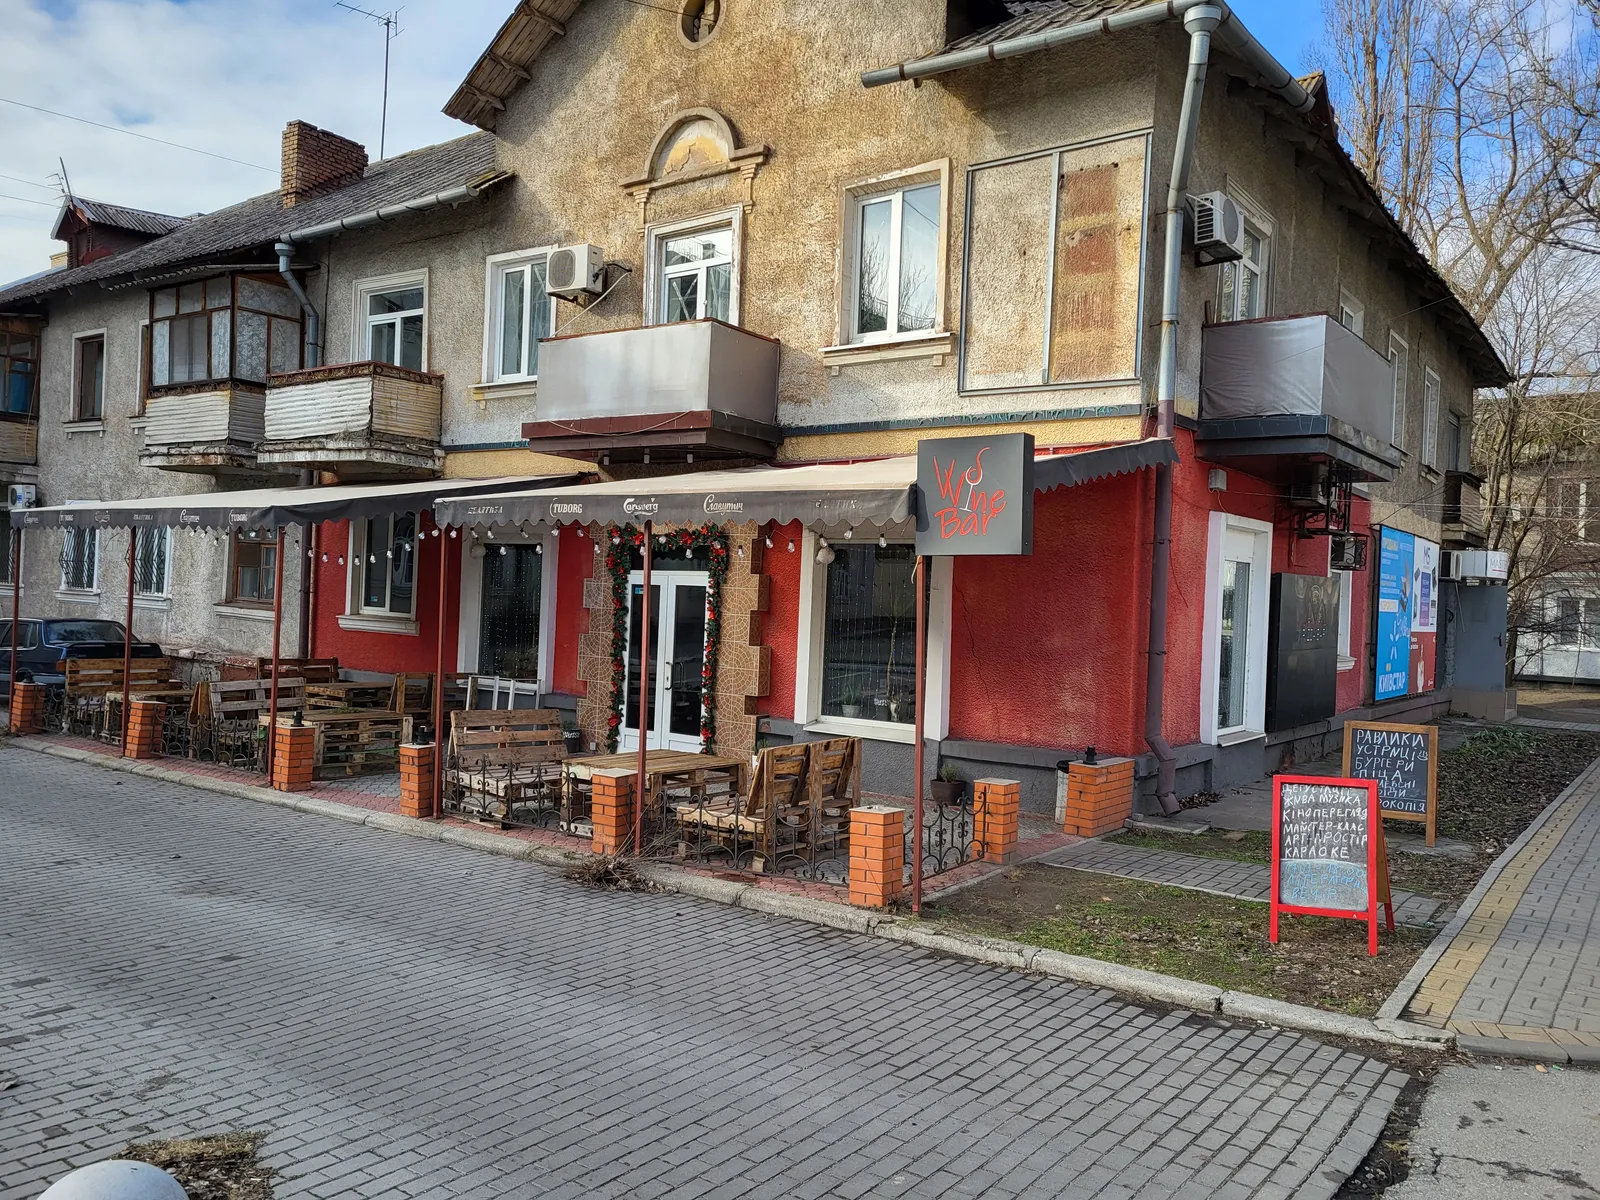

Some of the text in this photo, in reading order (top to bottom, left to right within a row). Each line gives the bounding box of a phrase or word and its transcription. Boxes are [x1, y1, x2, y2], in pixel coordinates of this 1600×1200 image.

[933, 446, 1007, 513] Wine
[552, 503, 583, 514] TUBORG
[703, 494, 743, 515] Славутич
[934, 507, 997, 539] Bar
[1356, 729, 1424, 747] РАВЛИКИ
[1355, 756, 1414, 772] БУРГЕРИ
[1283, 794, 1361, 806] ЖИВА МУЗИКА
[1283, 821, 1365, 835] МАЙСТЕР-КЛАС
[1284, 832, 1368, 846] АРТ-ПРОСТІР
[1285, 845, 1350, 859] КАРАОКЕ
